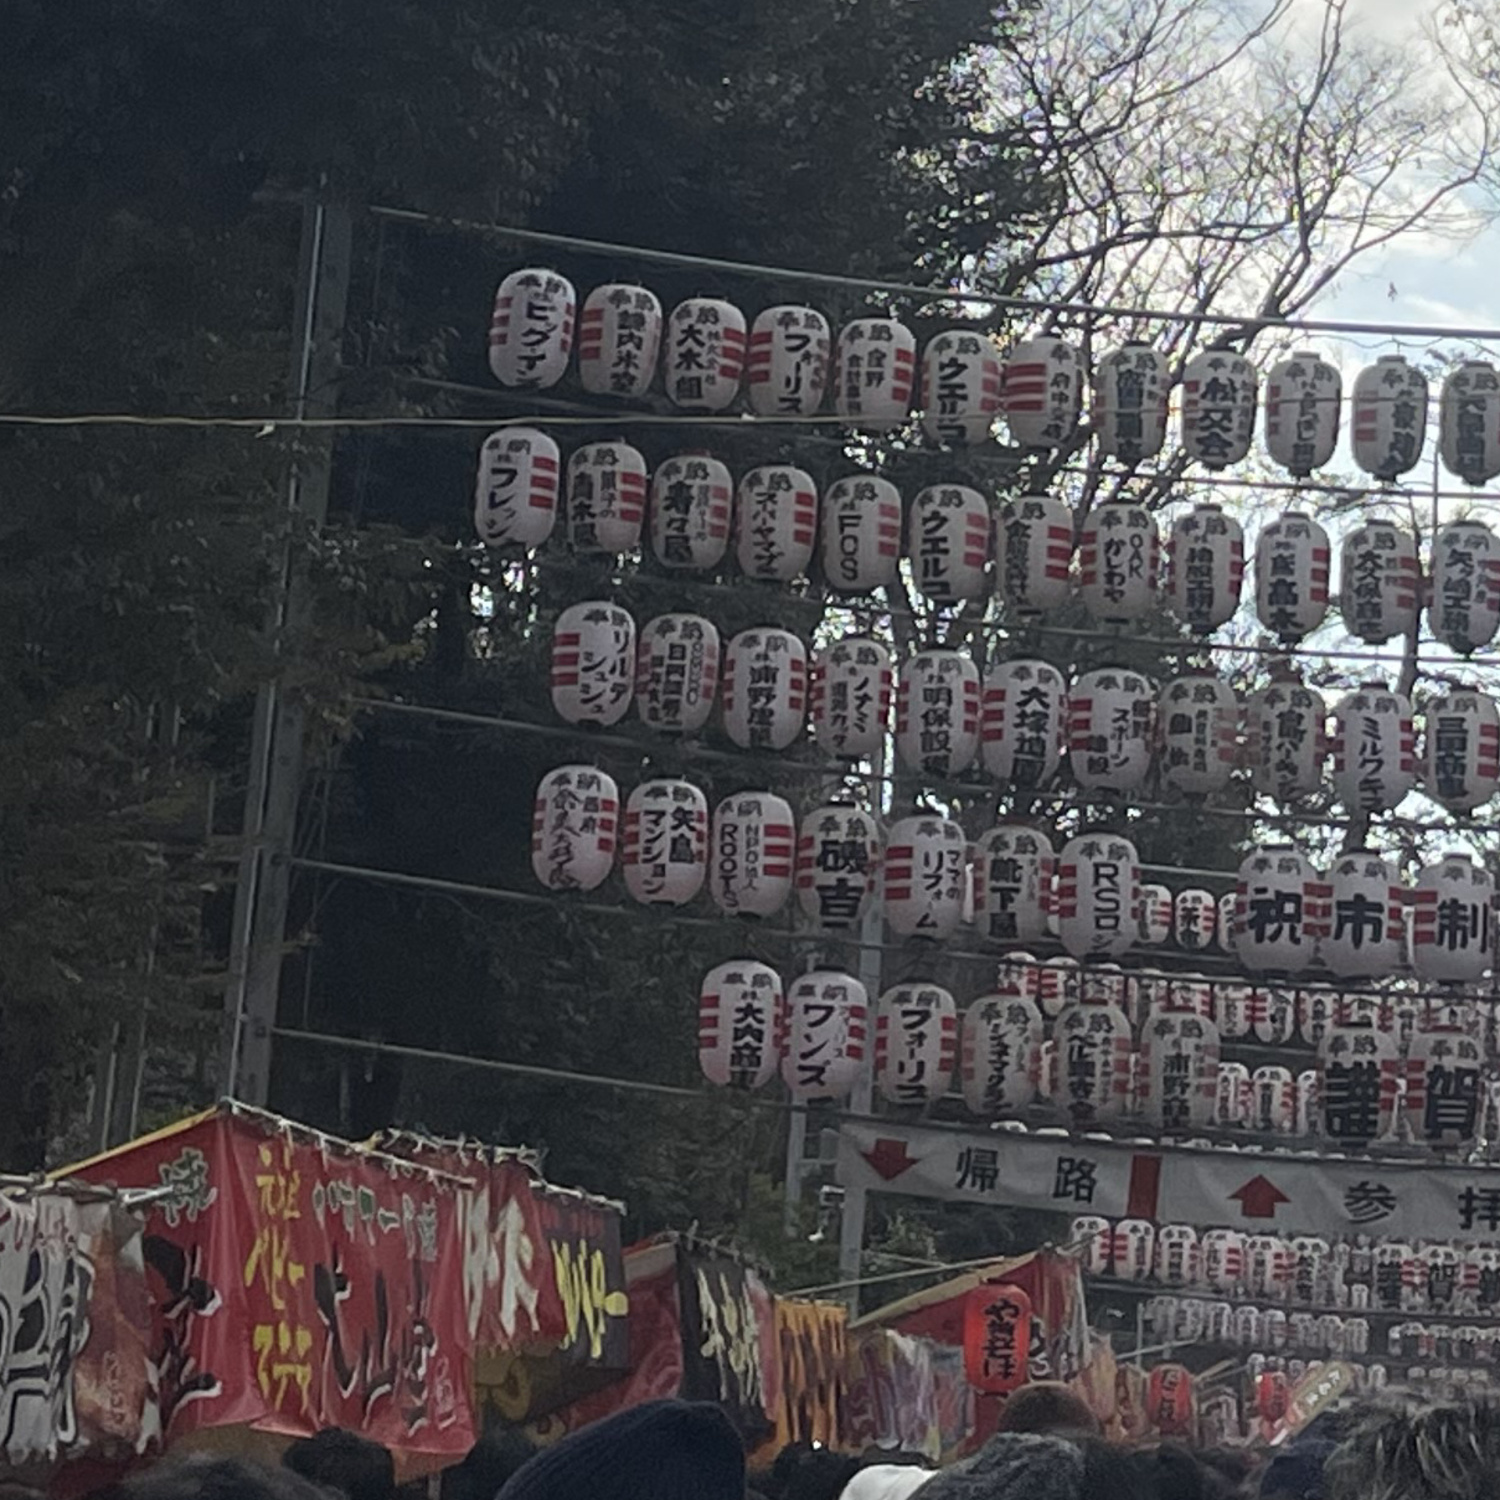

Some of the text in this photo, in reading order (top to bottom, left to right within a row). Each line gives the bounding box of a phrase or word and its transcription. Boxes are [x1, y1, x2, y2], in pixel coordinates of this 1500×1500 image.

[838, 513, 862, 581] FOS
[1103, 537, 1127, 603] かしわや
[644, 810, 667, 894] マンション
[719, 823, 738, 908] ROOTS
[916, 848, 944, 928] リフォーム
[797, 1004, 835, 1086] ワンズ
[896, 1009, 931, 1098] フォーリス
[957, 1146, 1097, 1203] 帰路
